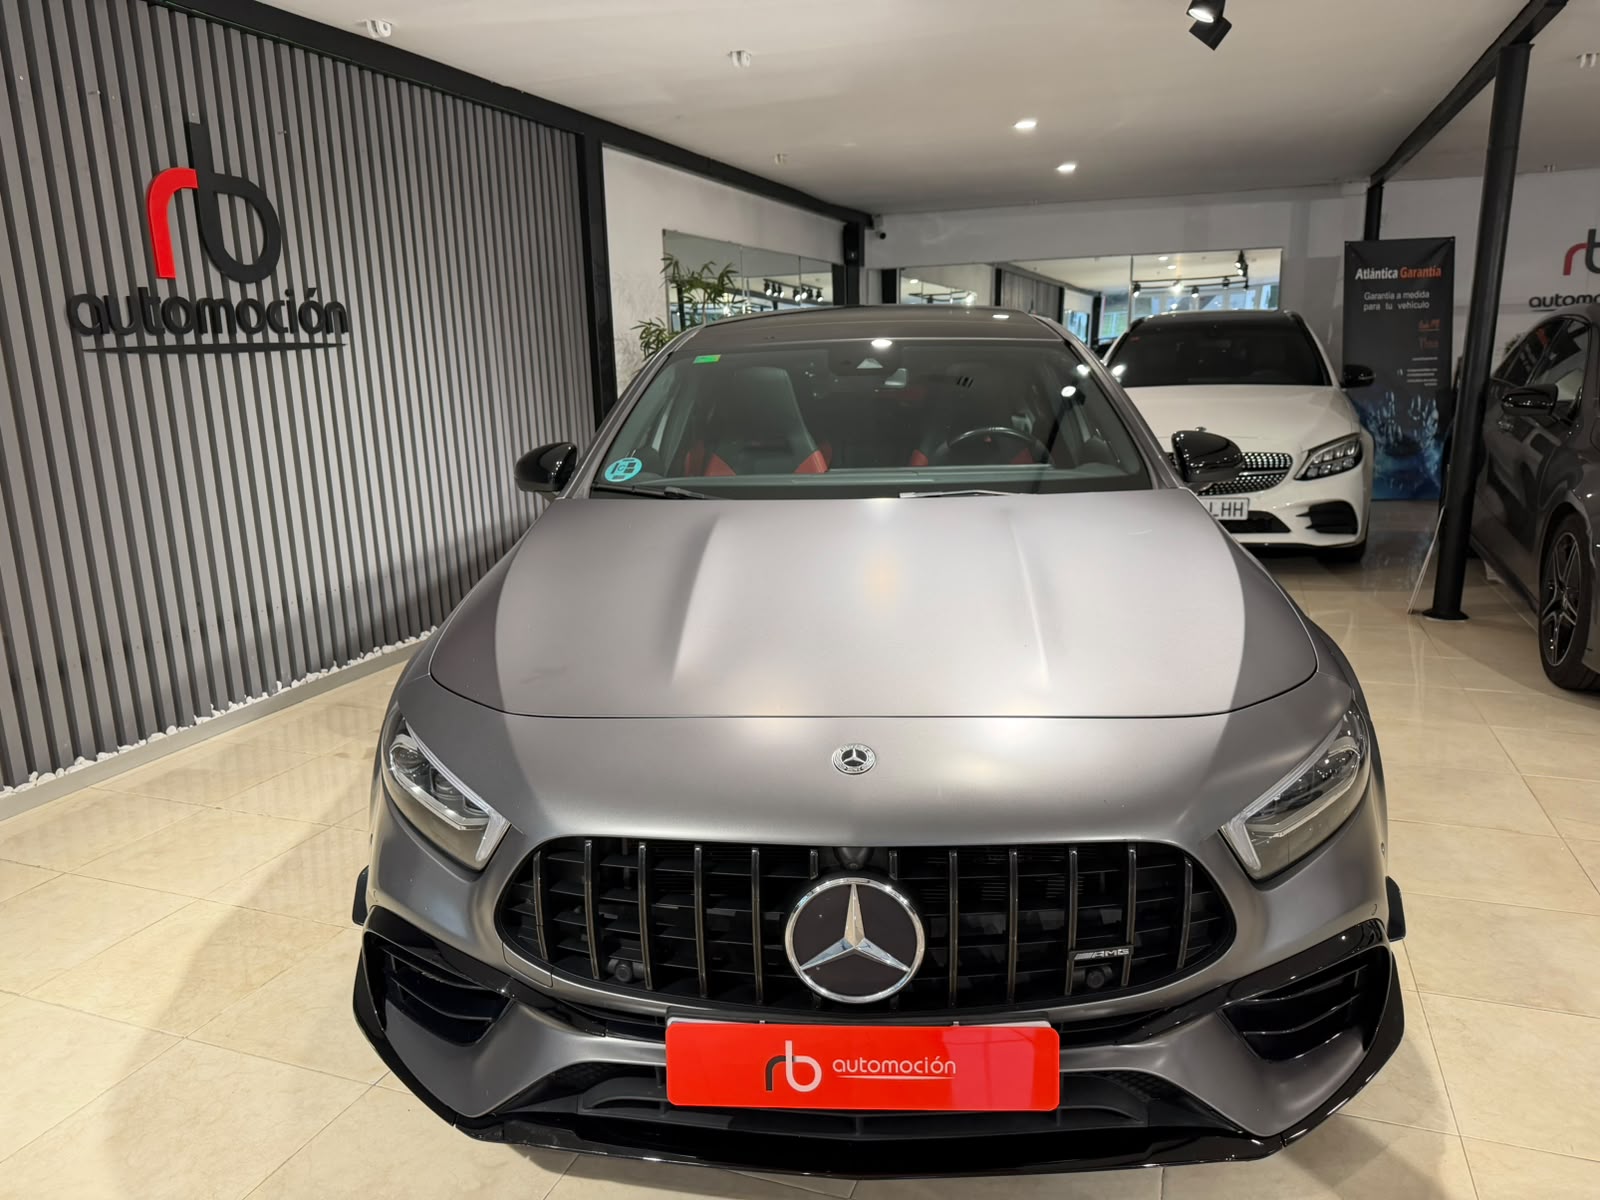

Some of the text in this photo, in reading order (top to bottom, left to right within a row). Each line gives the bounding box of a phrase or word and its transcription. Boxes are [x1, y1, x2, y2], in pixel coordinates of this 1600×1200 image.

[146, 121, 281, 284] rb
[1355, 265, 1441, 280] Atlántica Garantía
[1363, 303, 1381, 312] para
[1403, 290, 1430, 299] medida
[67, 286, 349, 336] automoción
[765, 1040, 957, 1092] rb automoción
